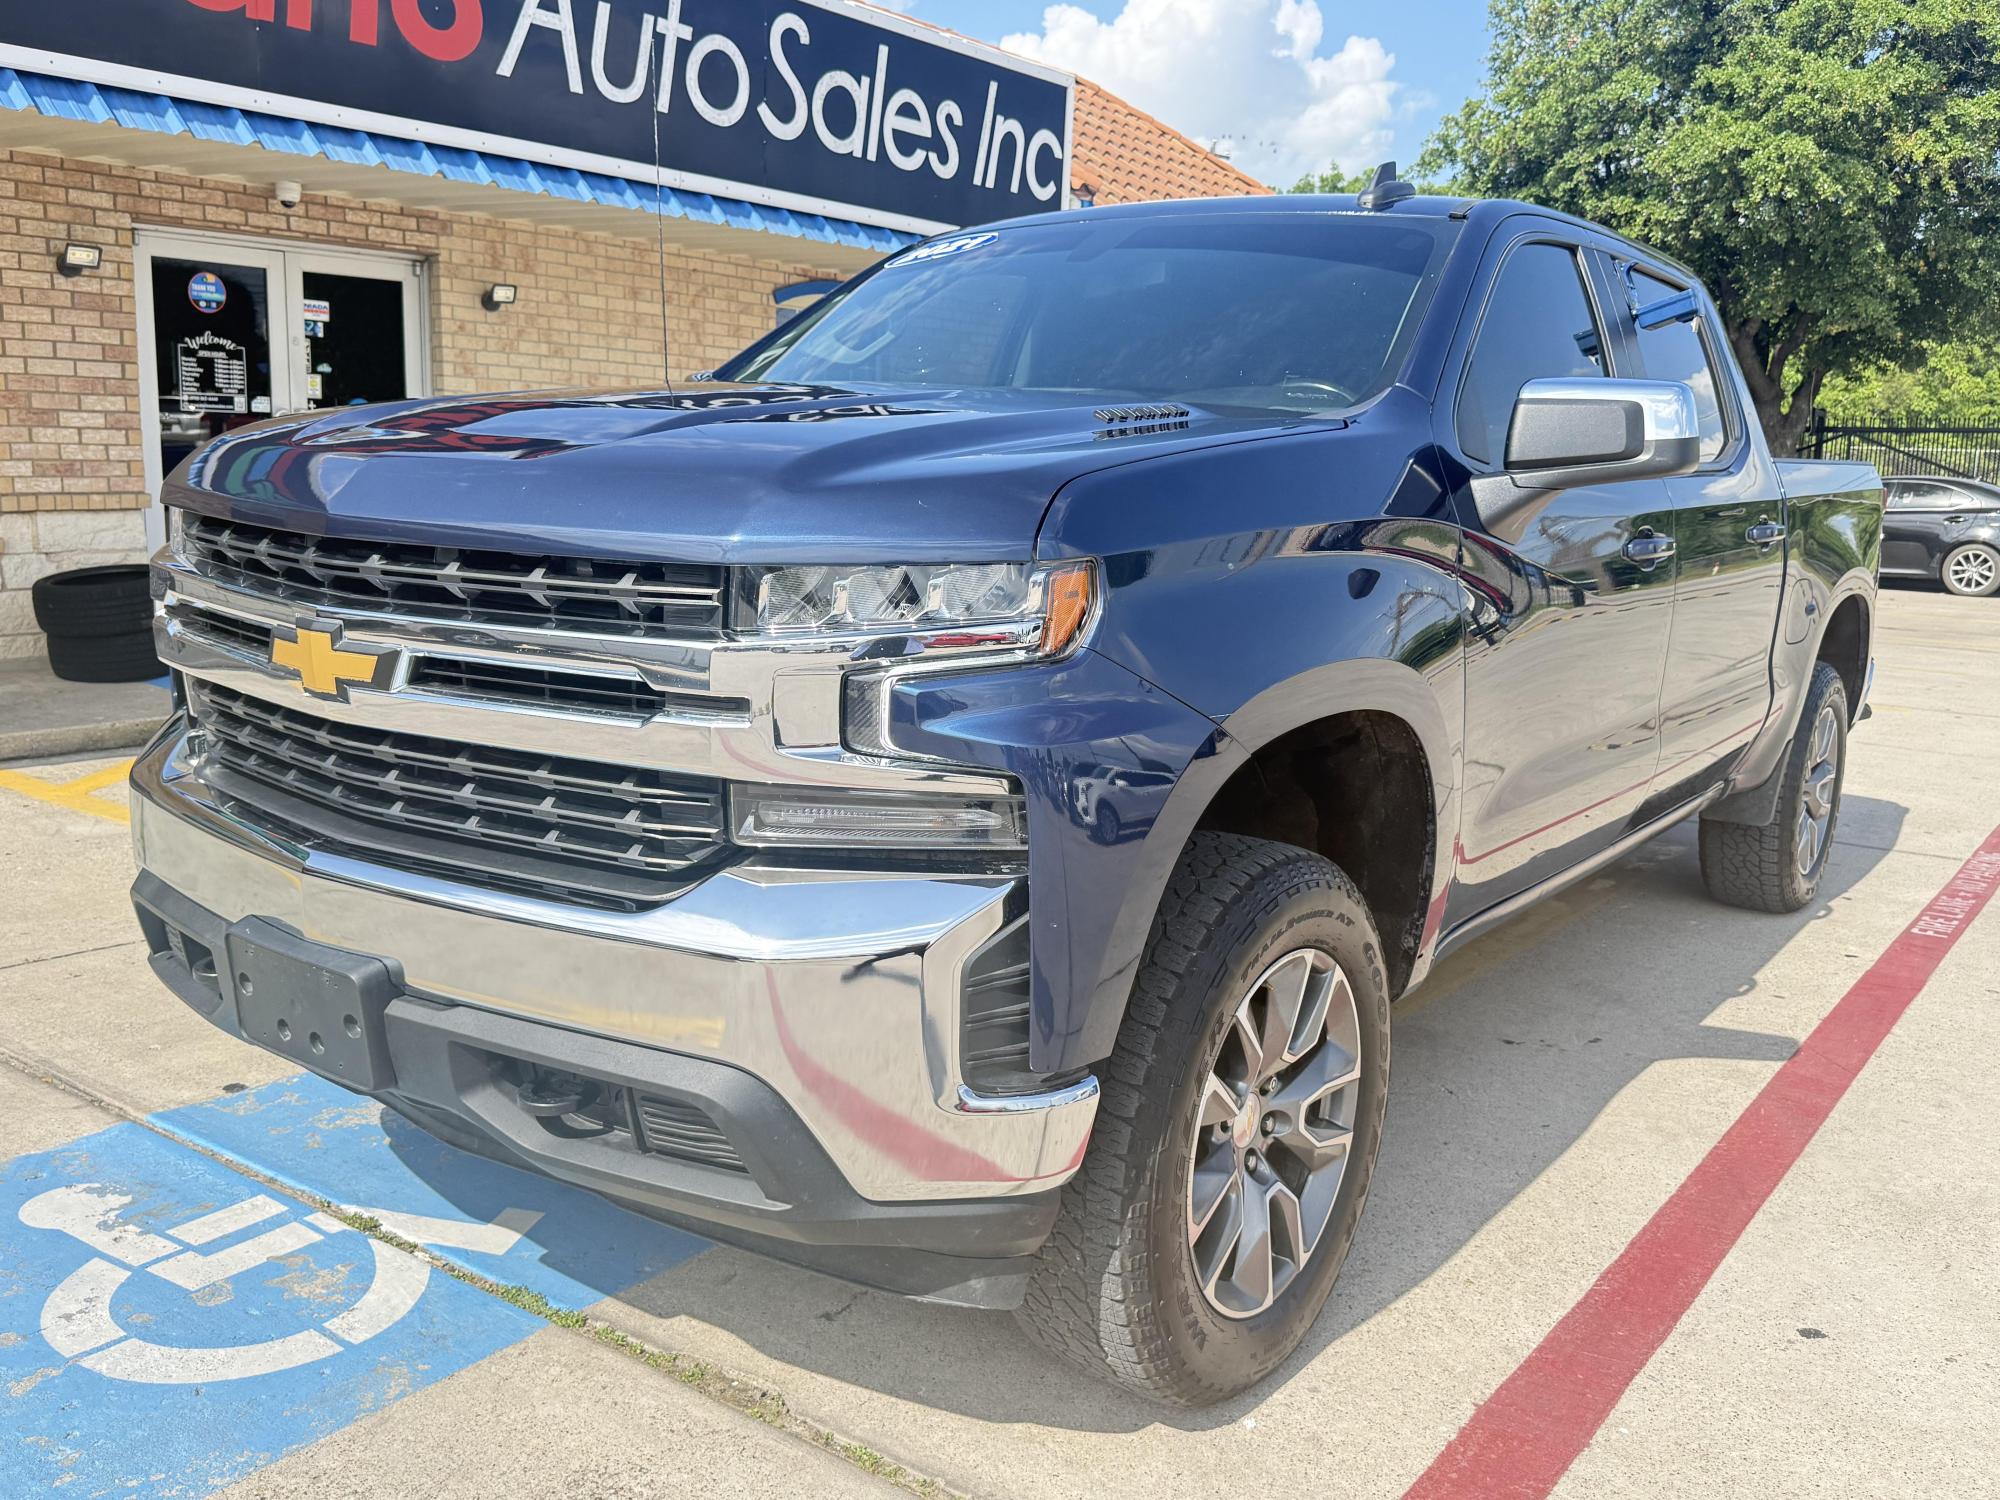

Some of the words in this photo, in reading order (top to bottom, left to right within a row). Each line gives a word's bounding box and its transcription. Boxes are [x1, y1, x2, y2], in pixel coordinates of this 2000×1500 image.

[496, 0, 750, 127] Auto
[757, 13, 963, 180] Sales
[973, 81, 1063, 202] Inc
[185, 331, 237, 350] Welcome
[1910, 916, 1960, 939] FIRE
